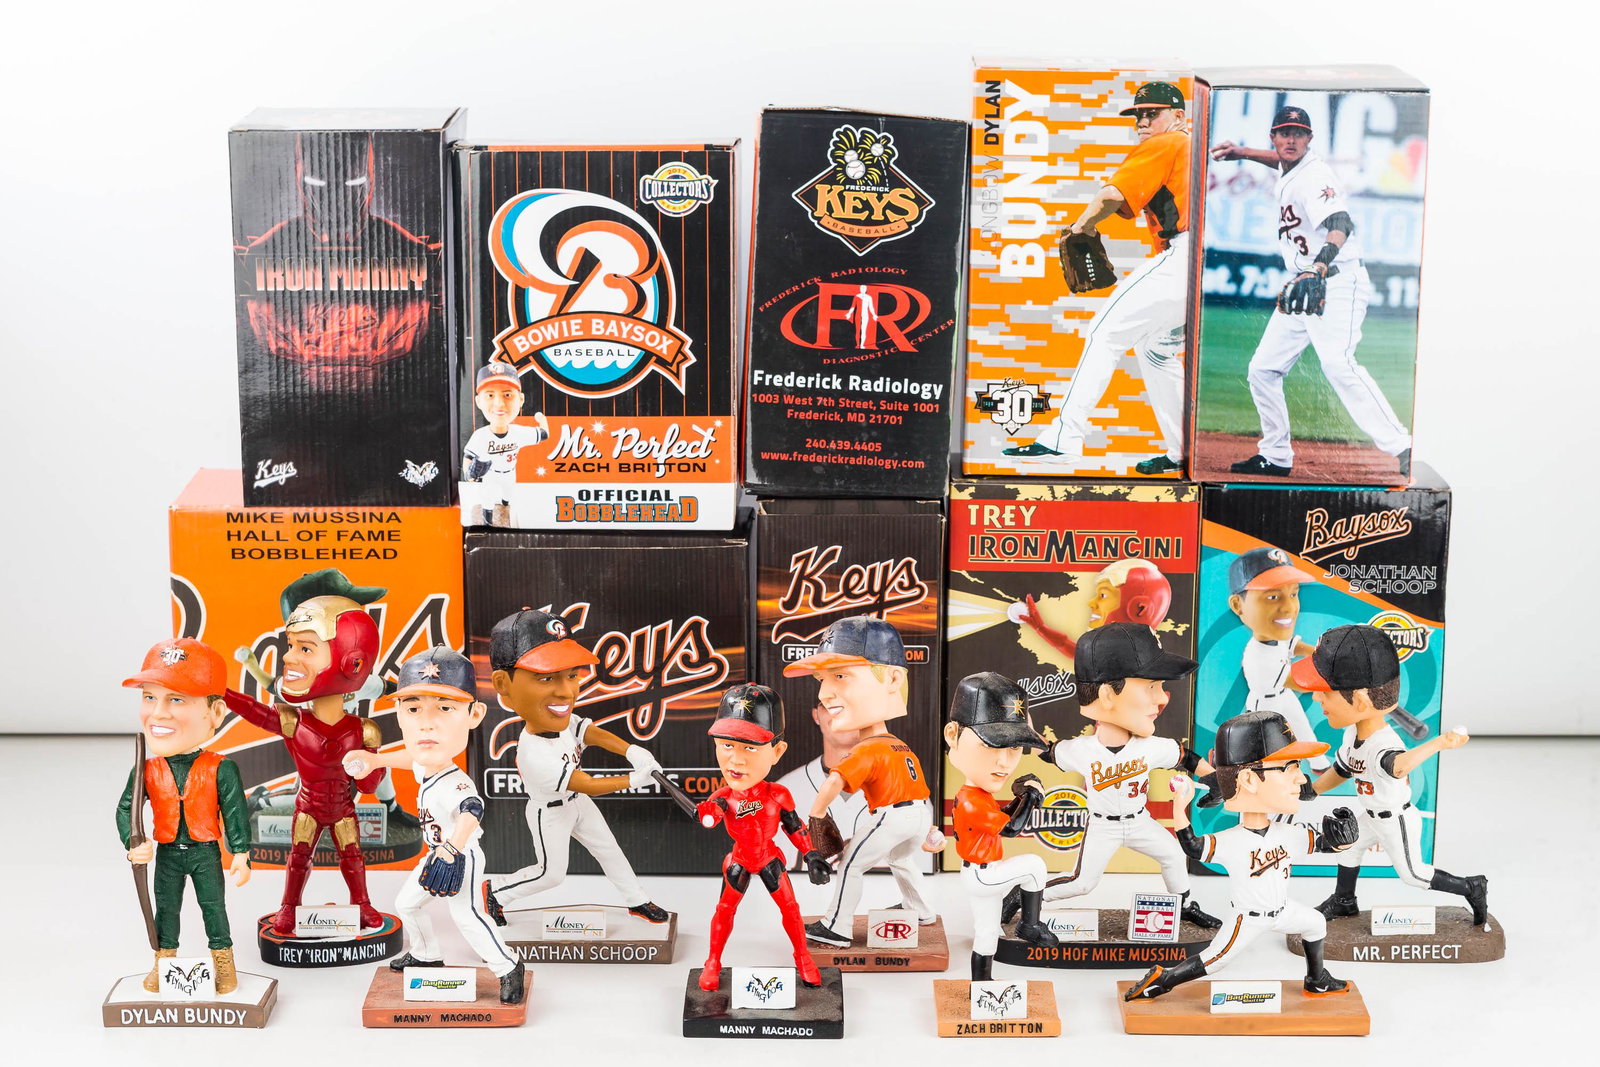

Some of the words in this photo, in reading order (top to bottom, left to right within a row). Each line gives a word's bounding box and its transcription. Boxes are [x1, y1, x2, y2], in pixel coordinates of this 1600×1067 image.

[983, 80, 1001, 146] DYLAN
[845, 184, 890, 192] FREDERICK
[1000, 79, 1050, 279] BUNDY
[813, 183, 920, 223] KEYS
[832, 221, 896, 235] BASEBALL
[256, 256, 323, 291] IRON
[329, 256, 428, 291] MANNY
[758, 275, 822, 312] FREDERICK
[831, 266, 908, 279] RADIOLOGY
[512, 317, 584, 355] BOWIE
[590, 317, 675, 355] BAYSOX
[823, 345, 900, 366] DIAGNOSTIC
[910, 318, 955, 346] CENTER
[553, 347, 637, 358] BASEBALL
[753, 369, 842, 390] Frederick
[848, 375, 944, 400] Radiology
[751, 393, 780, 404] 1003
[783, 394, 813, 406] West
[816, 396, 835, 407] 7th
[838, 397, 878, 411] Street,
[879, 400, 909, 412] Suite
[912, 402, 940, 413] 1001
[991, 390, 1033, 424] 30
[786, 409, 844, 423] Frederick,
[847, 412, 866, 423] MD
[869, 413, 903, 424] 21701
[547, 423, 602, 462] Mr.
[612, 423, 717, 478] Perfect
[805, 438, 882, 452] 240.439.4405
[554, 462, 610, 473] ZACH
[618, 462, 707, 473] BRITTON
[760, 450, 925, 469] www.frederickradiology.com
[253, 458, 298, 490] Keys
[577, 489, 674, 503] OFFICIAL
[226, 511, 285, 524] MIKE
[292, 511, 403, 524] MUSSINA
[555, 495, 699, 523] BOBBLEHEAD
[968, 504, 1037, 529] TREY
[226, 530, 290, 542] HALL
[295, 530, 328, 542] OF
[336, 530, 402, 542] FAME
[1299, 507, 1414, 563] Baysox
[231, 548, 399, 560] BOBBLEHEAD
[969, 535, 1039, 562] IRON
[1043, 530, 1182, 563] MANCINI
[1323, 564, 1437, 580] JONATHAN
[772, 545, 929, 645] Keys
[1348, 579, 1437, 594] SCHOOP
[904, 756, 918, 782] 6
[1090, 756, 1148, 792] Baysox
[1054, 791, 1077, 800] 2018
[735, 799, 764, 820] Keys
[430, 824, 443, 844] 3
[254, 848, 281, 861] 2019
[1250, 845, 1288, 878] Keys
[279, 947, 303, 964] TREY
[343, 942, 386, 961] MANCINI
[590, 946, 658, 961] SCHOOP
[832, 956, 866, 966] DYLAN
[875, 957, 910, 967] BUNDY
[1027, 946, 1059, 961] 2019
[1062, 947, 1089, 961] HOF
[1092, 947, 1126, 962] MIKE
[1128, 947, 1187, 962] MUSSINA
[1353, 946, 1386, 961] MR.
[1391, 944, 1462, 960] PERFECT
[1226, 993, 1276, 1002] BayRunner
[120, 1007, 179, 1026] DYLAN
[184, 1008, 248, 1026] BUNDY
[393, 1013, 432, 1024] MANNY
[440, 1013, 492, 1023] MACHADO
[719, 1025, 756, 1035] MANNY
[762, 1026, 813, 1037] MACHADO
[957, 1023, 986, 1035] ZACH
[990, 1023, 1043, 1034] BRITTON
